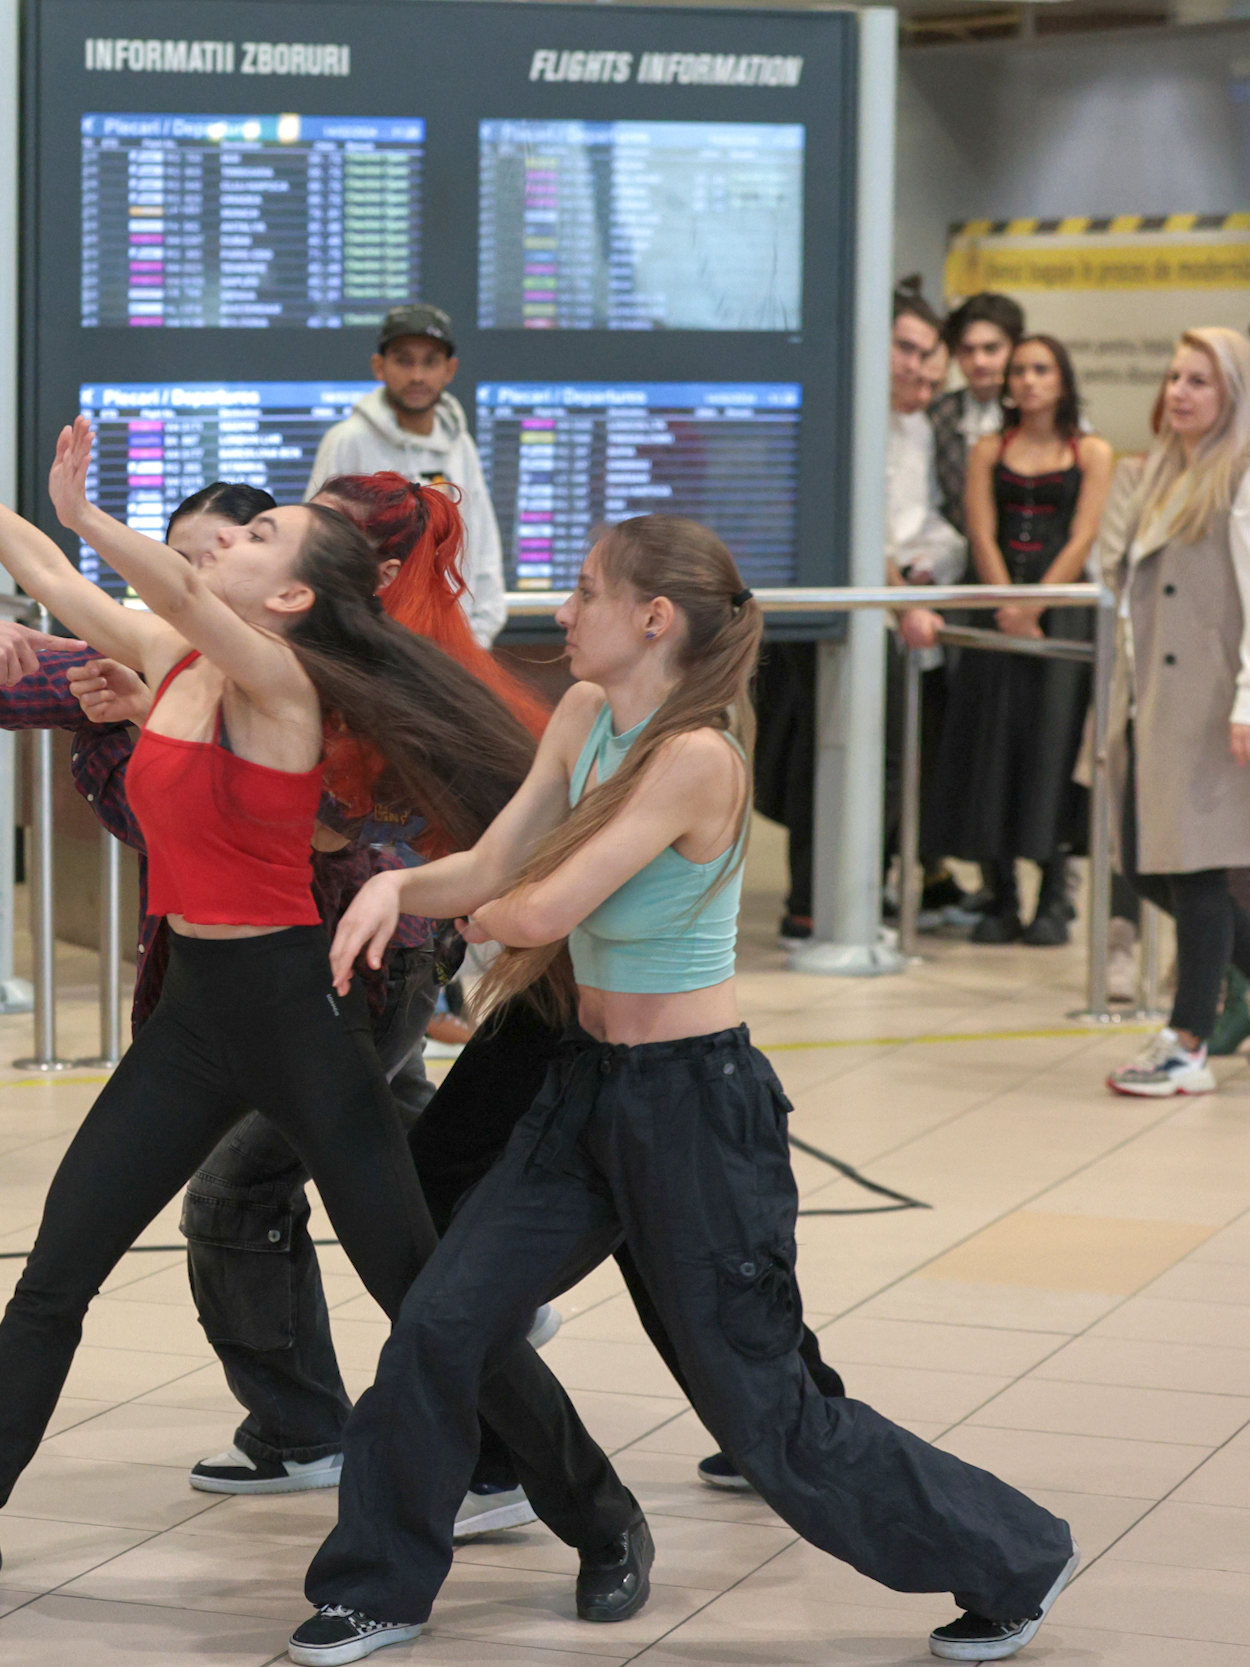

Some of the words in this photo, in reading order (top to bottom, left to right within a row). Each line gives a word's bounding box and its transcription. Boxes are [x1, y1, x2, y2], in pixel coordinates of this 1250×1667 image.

[85, 38, 234, 73] INFORMATII
[240, 42, 350, 76] ZBORURI
[529, 49, 633, 83] FLIGHTS
[637, 52, 803, 87] INFORMATION
[104, 117, 160, 136] Plecari
[103, 389, 160, 406] Plecari
[171, 388, 260, 409] Departures
[498, 387, 550, 405] Plecari
[563, 387, 647, 408] Departures
